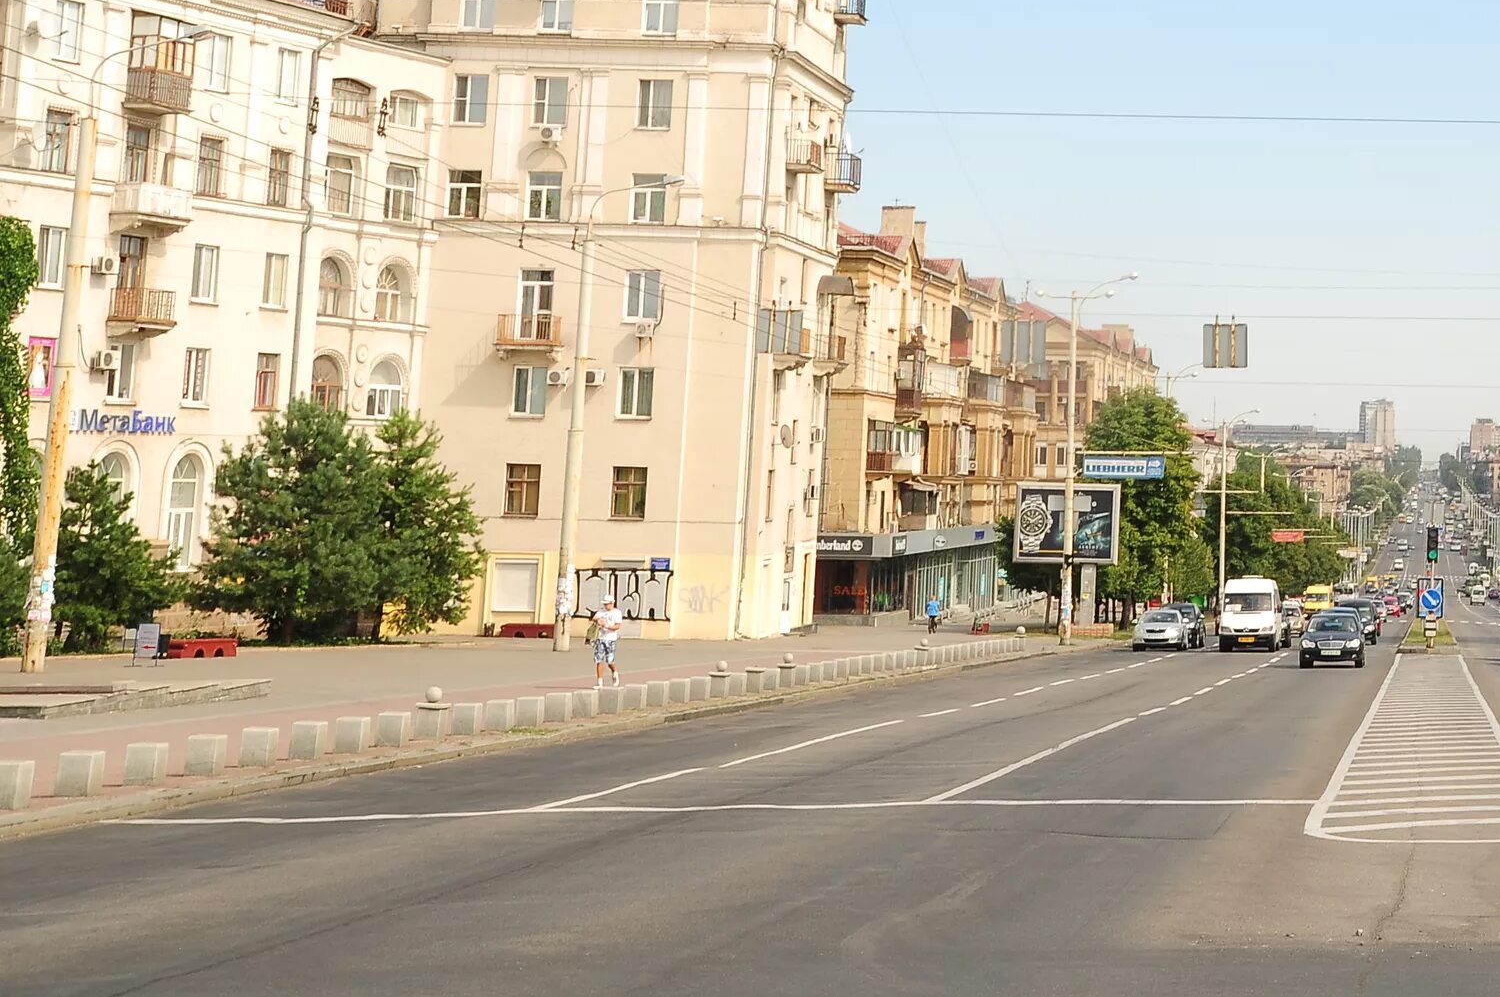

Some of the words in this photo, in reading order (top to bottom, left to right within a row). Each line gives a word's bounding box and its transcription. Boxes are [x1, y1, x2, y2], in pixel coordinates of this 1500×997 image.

[80, 409, 176, 432] МетаБанк
[1086, 465, 1144, 473] LIEBHERR
[816, 539, 851, 551] mberland
